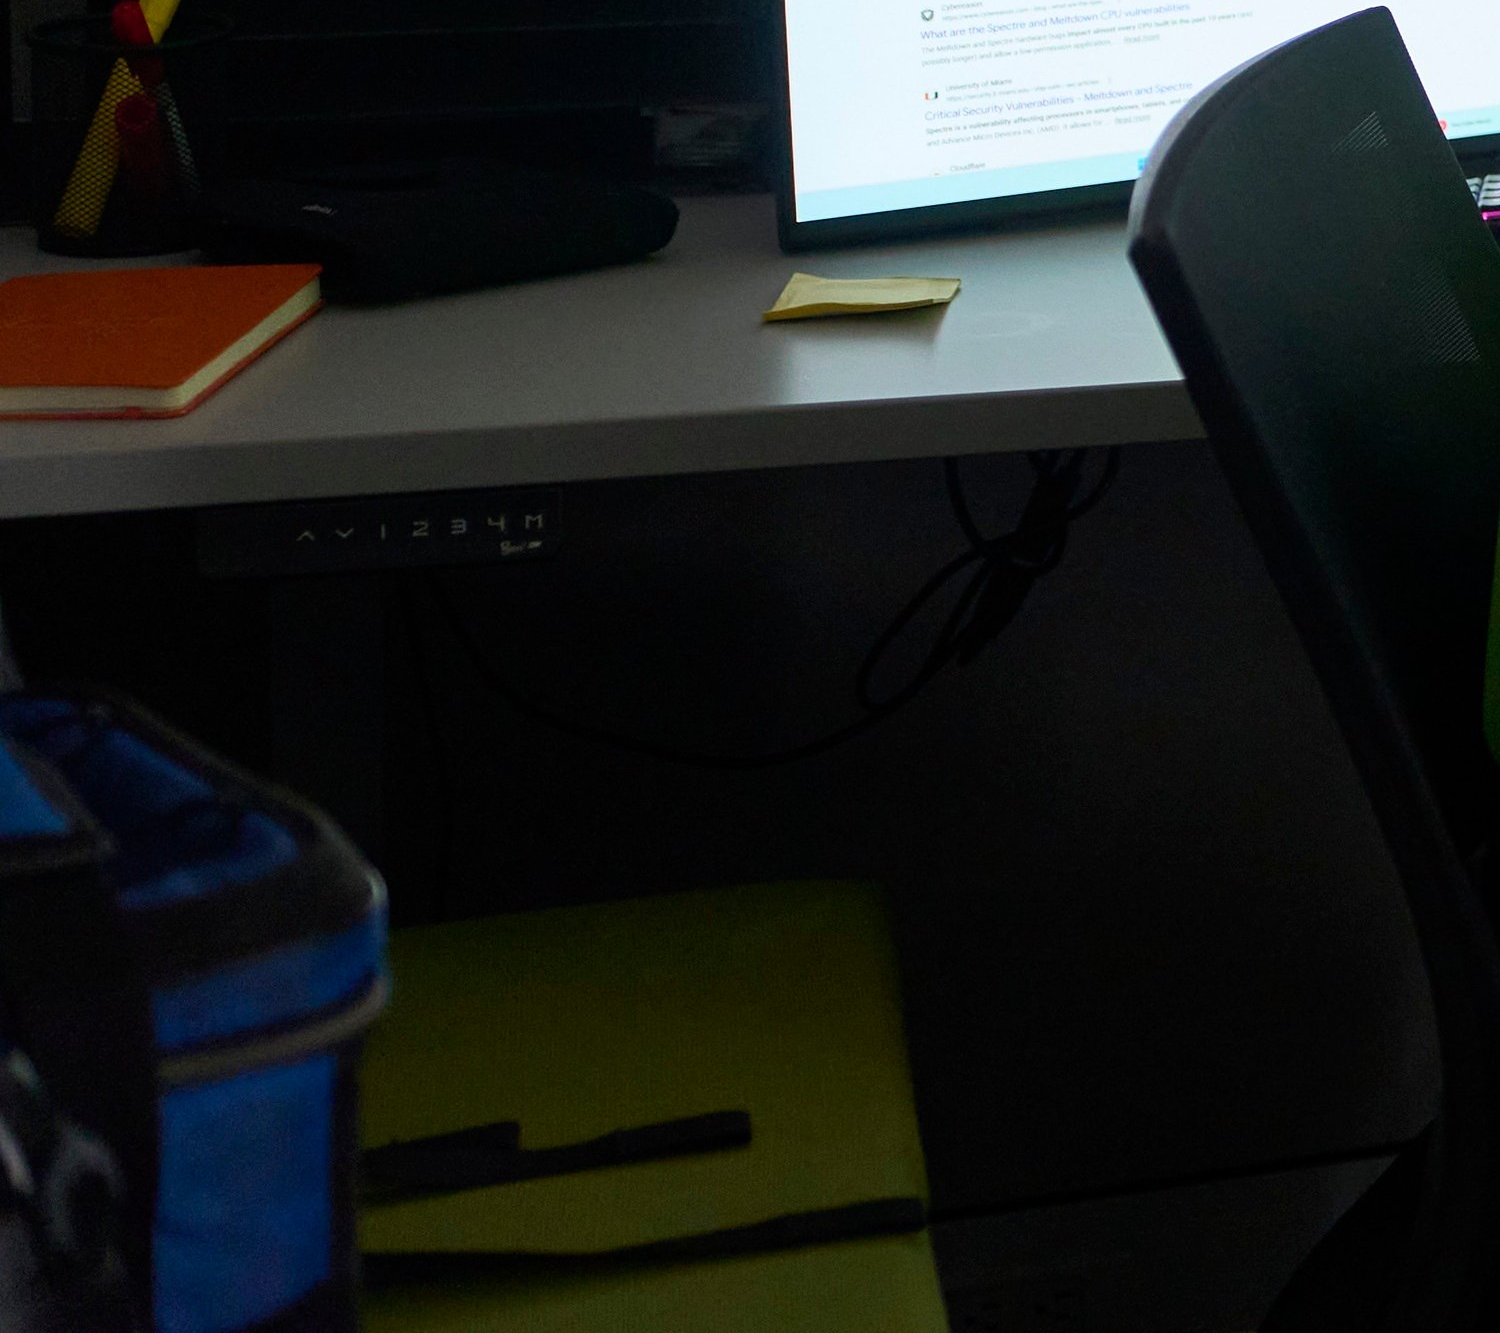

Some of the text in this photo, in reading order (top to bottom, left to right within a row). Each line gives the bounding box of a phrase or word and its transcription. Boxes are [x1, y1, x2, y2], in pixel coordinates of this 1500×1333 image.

[920, 4, 1190, 39] What are the Spectre and Meltdown CPU vulnerabilities
[945, 82, 982, 92] University
[925, 82, 1193, 121] Critical Security Vulnerabilities Meltdown and Spectre
[413, 521, 430, 536] 2
[451, 519, 468, 534] 3
[488, 514, 506, 532] 4
[525, 514, 544, 530] M
